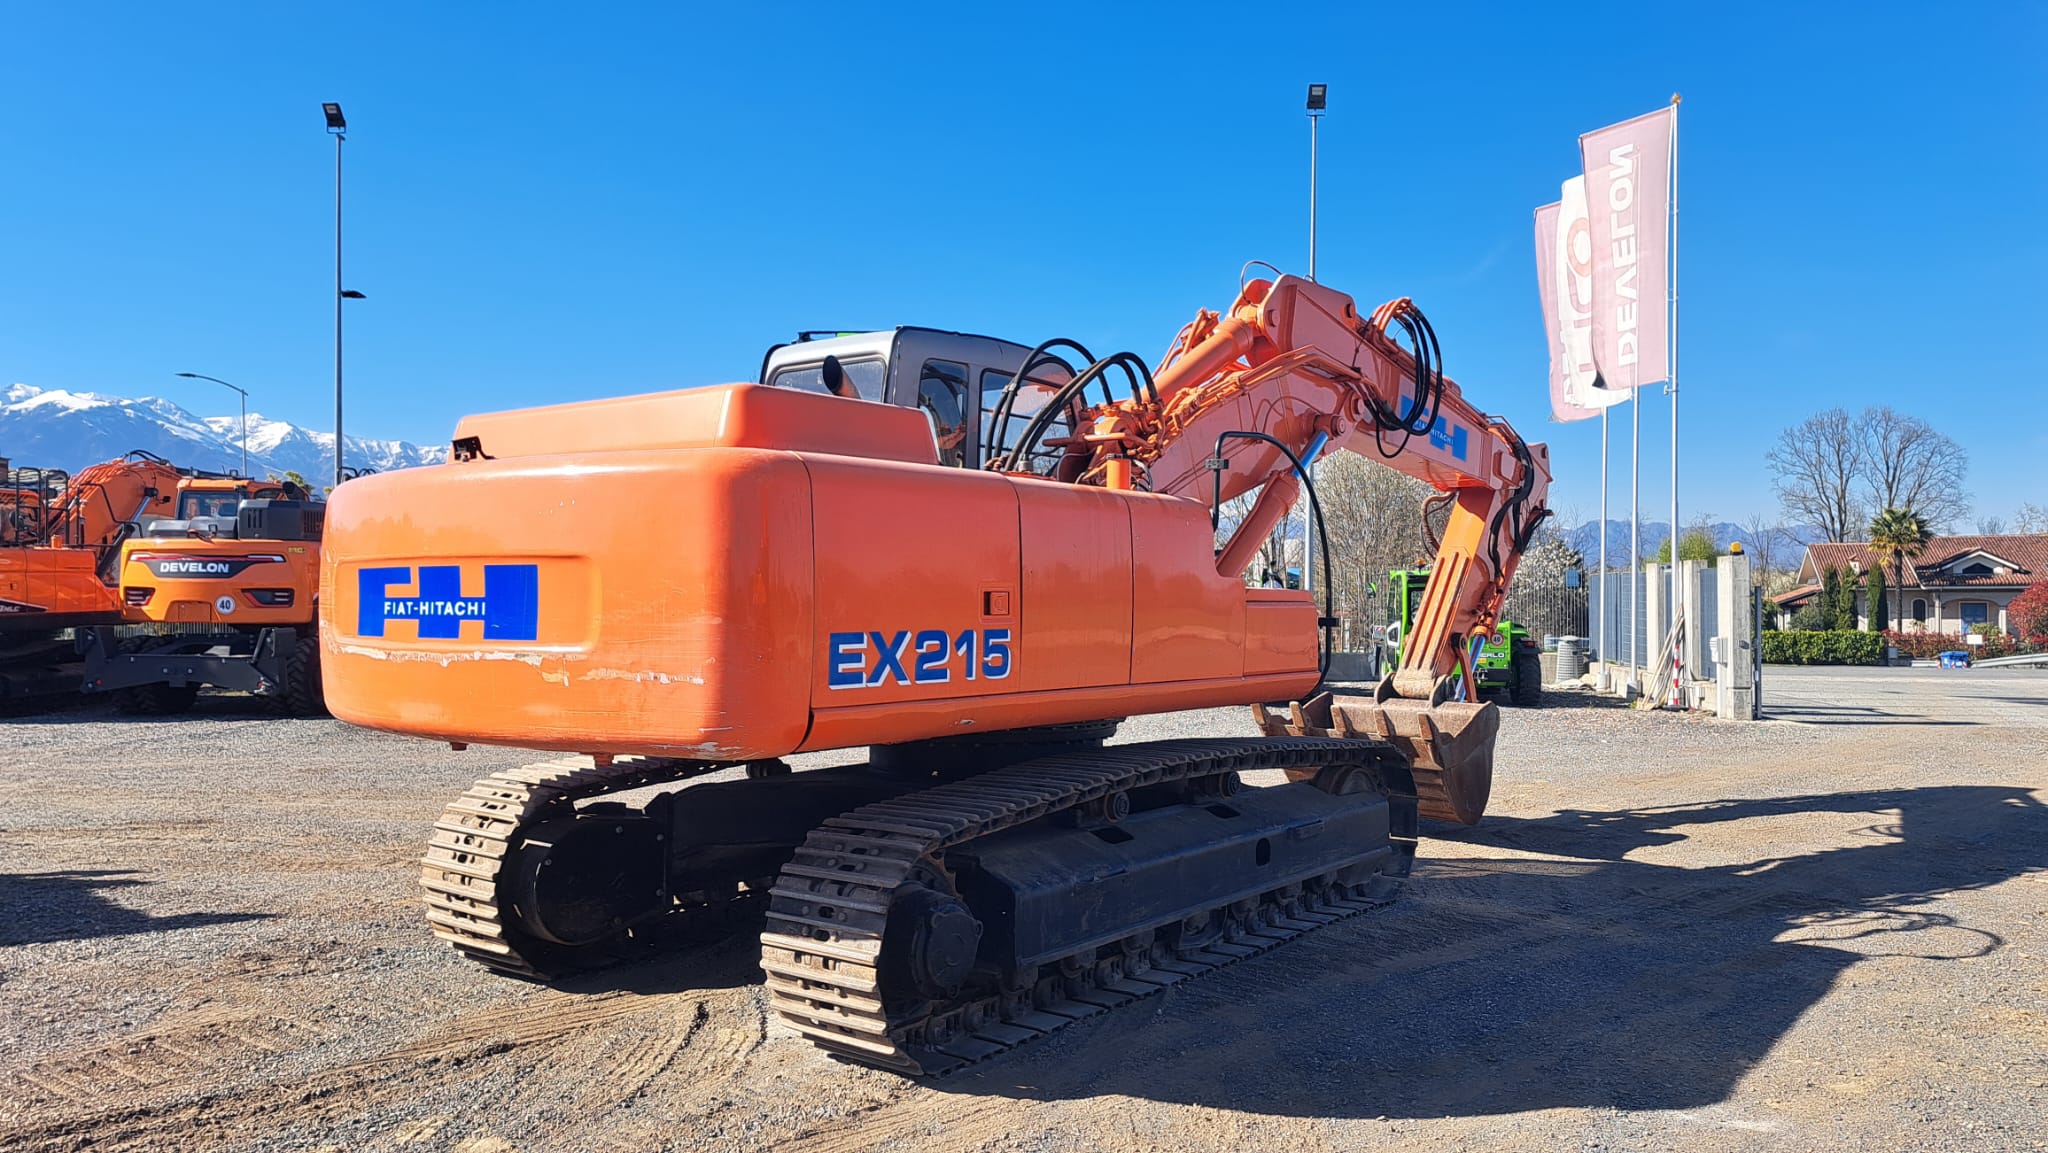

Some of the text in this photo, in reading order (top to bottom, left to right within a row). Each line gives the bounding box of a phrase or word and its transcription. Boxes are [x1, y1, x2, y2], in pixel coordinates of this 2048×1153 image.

[160, 562, 229, 573] DEVELON
[219, 599, 231, 610] 40
[384, 601, 486, 616] FIAT-HITACHI
[828, 629, 1012, 690] EX215
